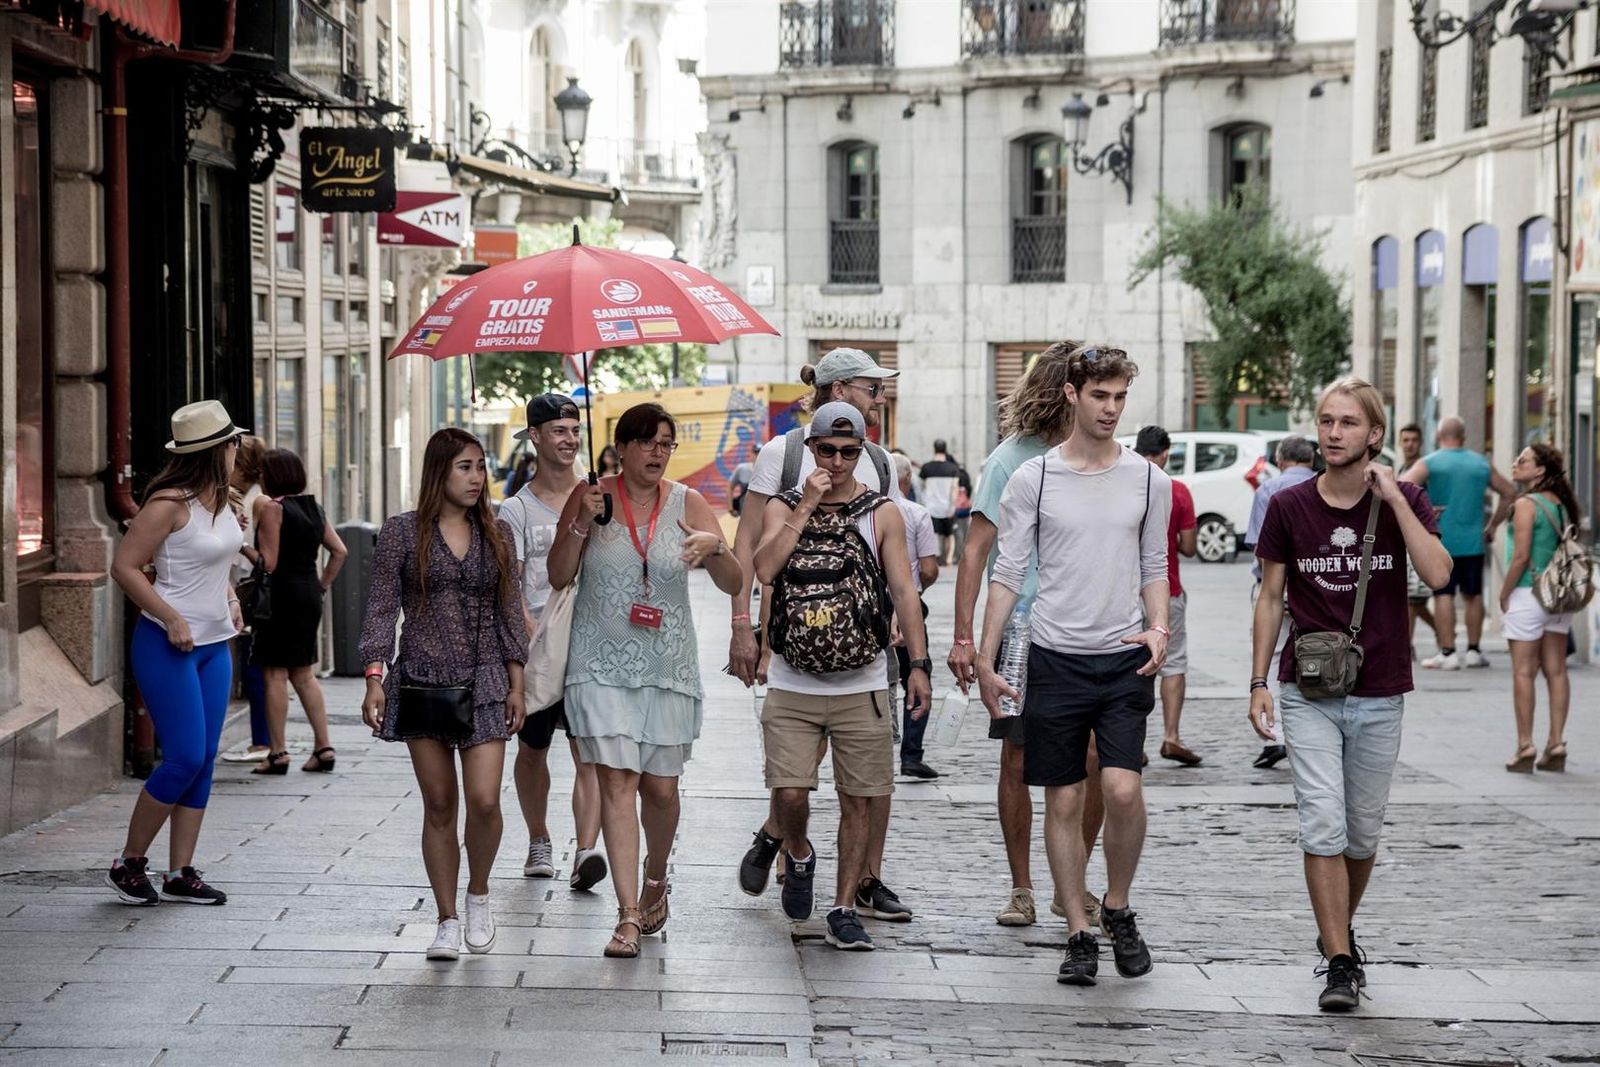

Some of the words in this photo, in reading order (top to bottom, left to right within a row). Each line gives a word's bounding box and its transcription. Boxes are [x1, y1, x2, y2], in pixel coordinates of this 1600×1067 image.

[312, 146, 381, 177] Angel
[322, 188, 344, 197] arte
[346, 188, 376, 197] sacro
[420, 210, 460, 227] ATM
[686, 285, 729, 304] FREE
[488, 297, 552, 318] TOUR
[703, 301, 746, 322] TOUR
[480, 318, 544, 336] GRATIS
[803, 309, 901, 329] McDonald's
[475, 336, 516, 348] EMPIEZA
[516, 334, 541, 346] AQUÍ
[1297, 557, 1342, 573] WOODEN
[1346, 554, 1394, 572] WODER
